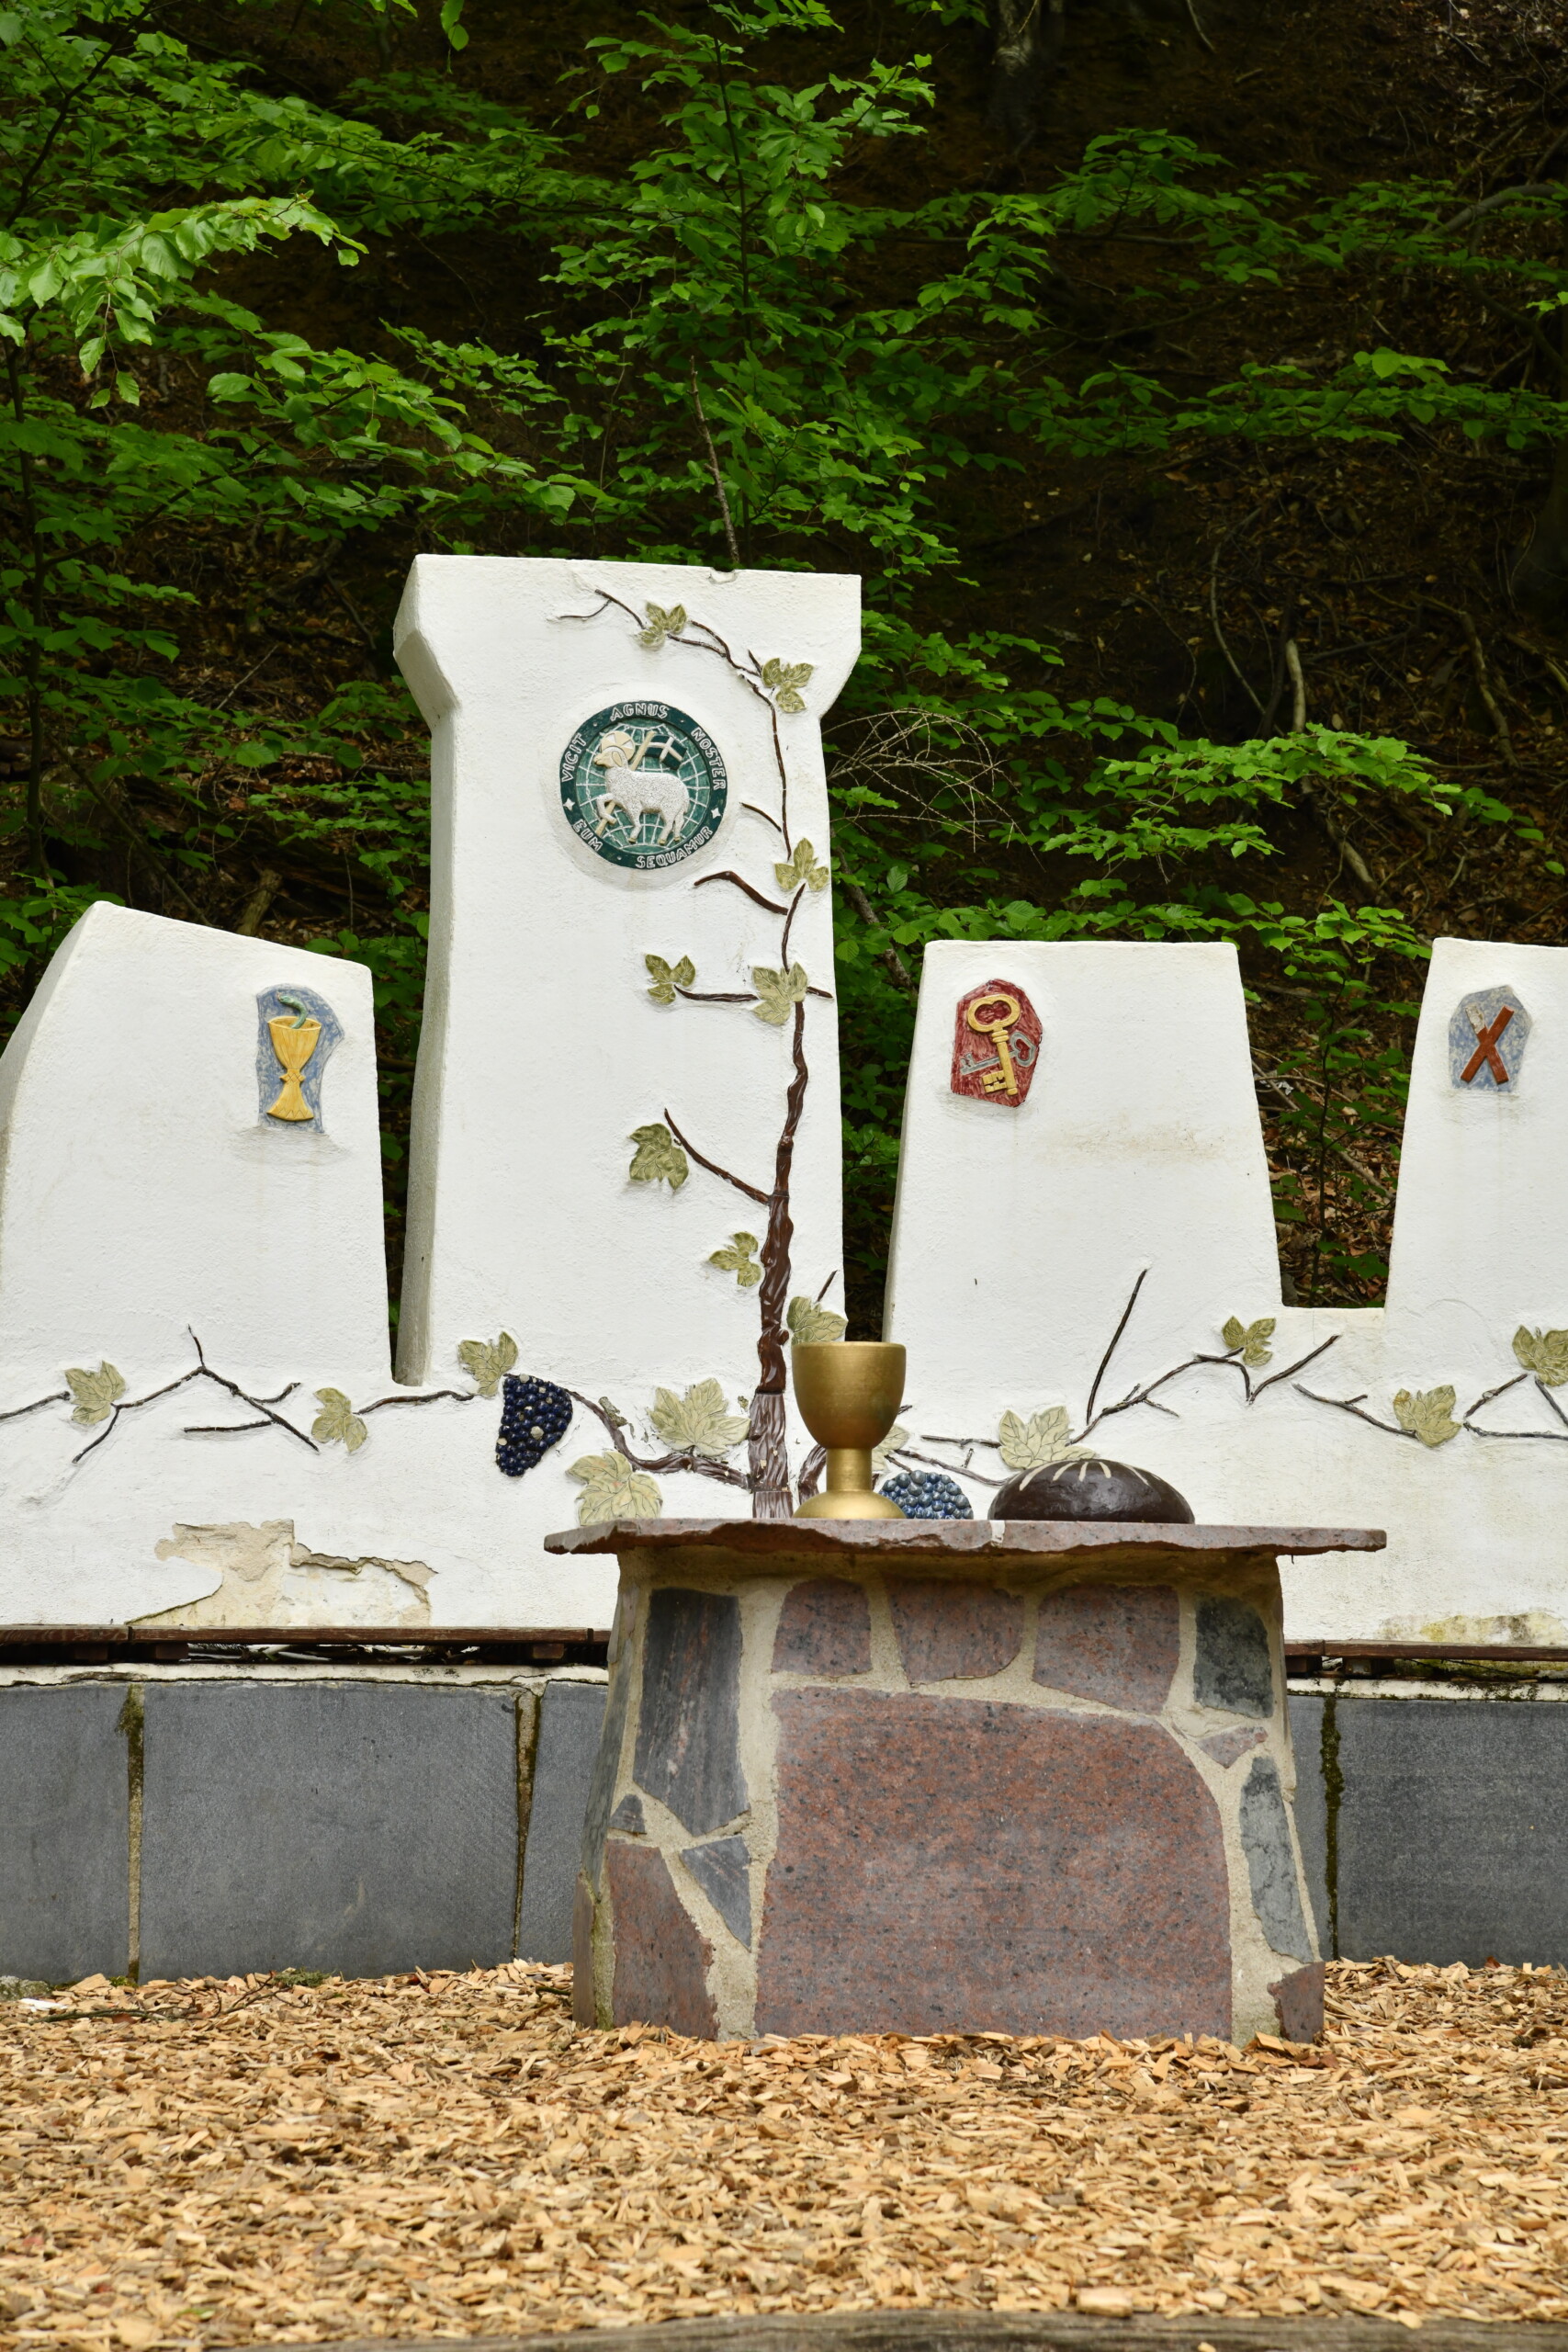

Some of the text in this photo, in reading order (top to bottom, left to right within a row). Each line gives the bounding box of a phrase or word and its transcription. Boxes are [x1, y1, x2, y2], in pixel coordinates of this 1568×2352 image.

[561, 703, 727, 790] VICIT AGNUS NOSTER
[572, 820, 714, 869] EUM SEQUAMUR
